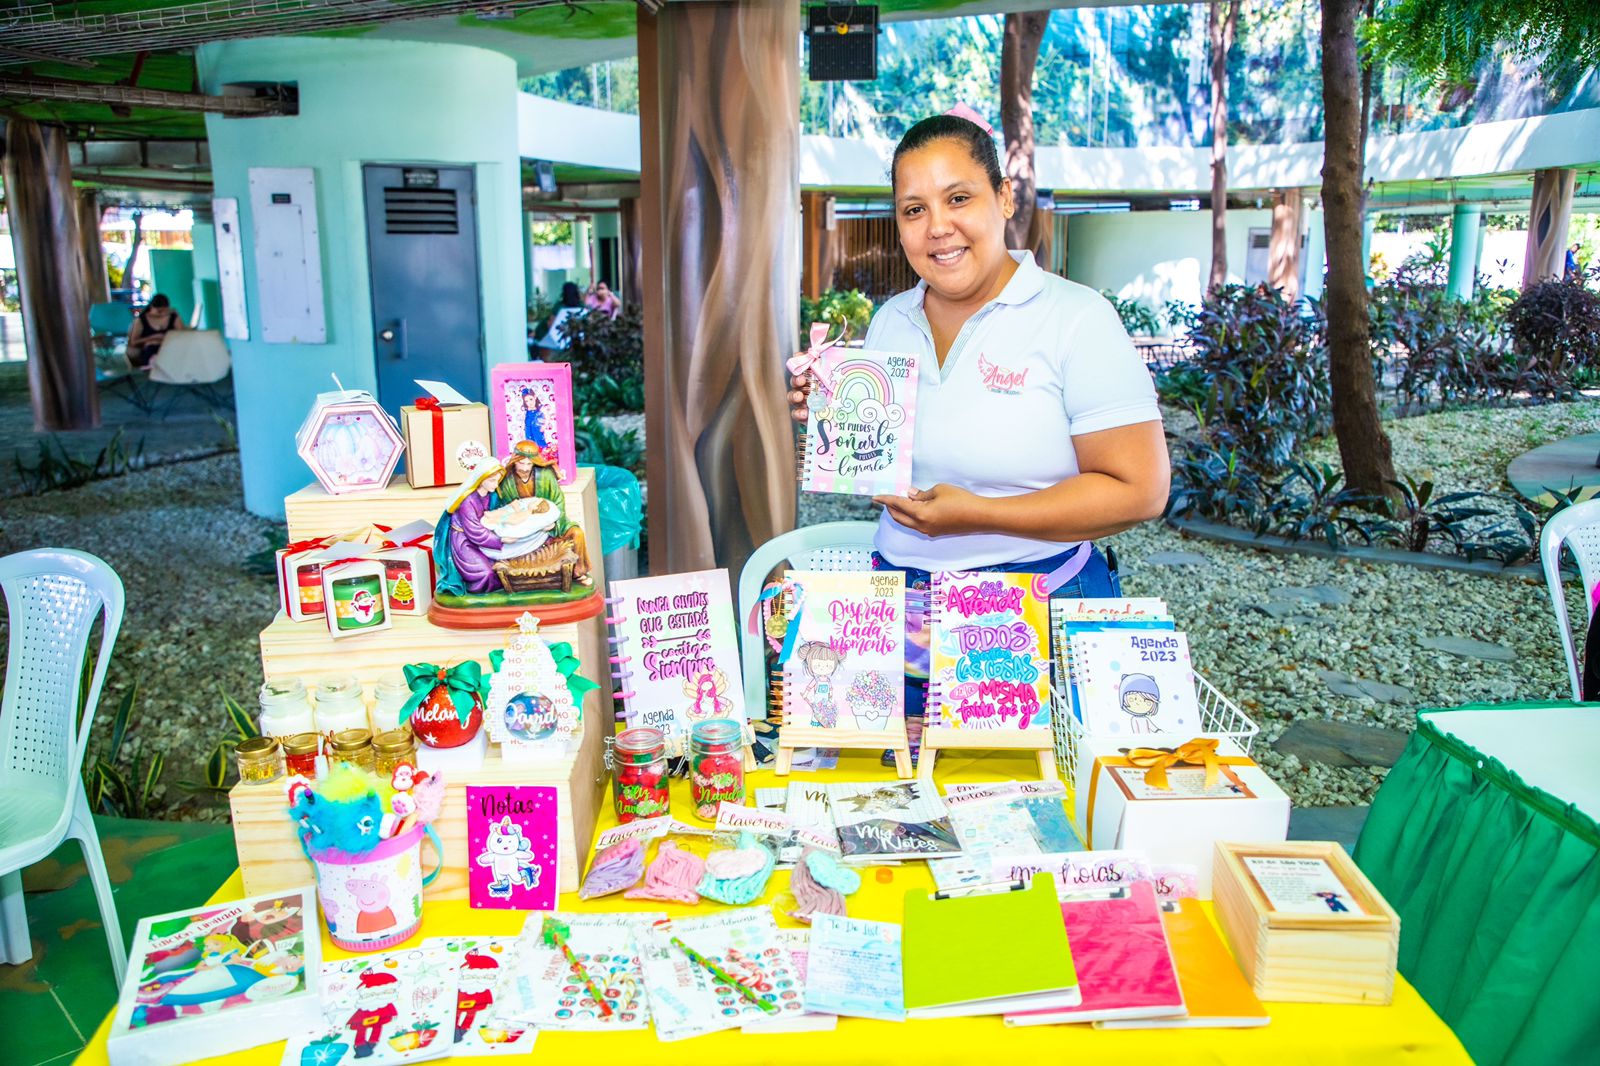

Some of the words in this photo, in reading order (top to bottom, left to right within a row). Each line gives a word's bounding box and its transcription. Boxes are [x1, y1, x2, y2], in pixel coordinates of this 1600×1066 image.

[887, 356, 915, 368] Agenda
[890, 367, 910, 378] 2023
[816, 418, 898, 455] Soñarlo
[870, 576, 899, 587] Agenda
[874, 587, 894, 598] 2023
[828, 597, 899, 624] Disfruta
[1131, 636, 1179, 649] Agenda
[1140, 650, 1177, 662] 2023
[642, 708, 675, 725] Agenda
[481, 794, 534, 816] Notas
